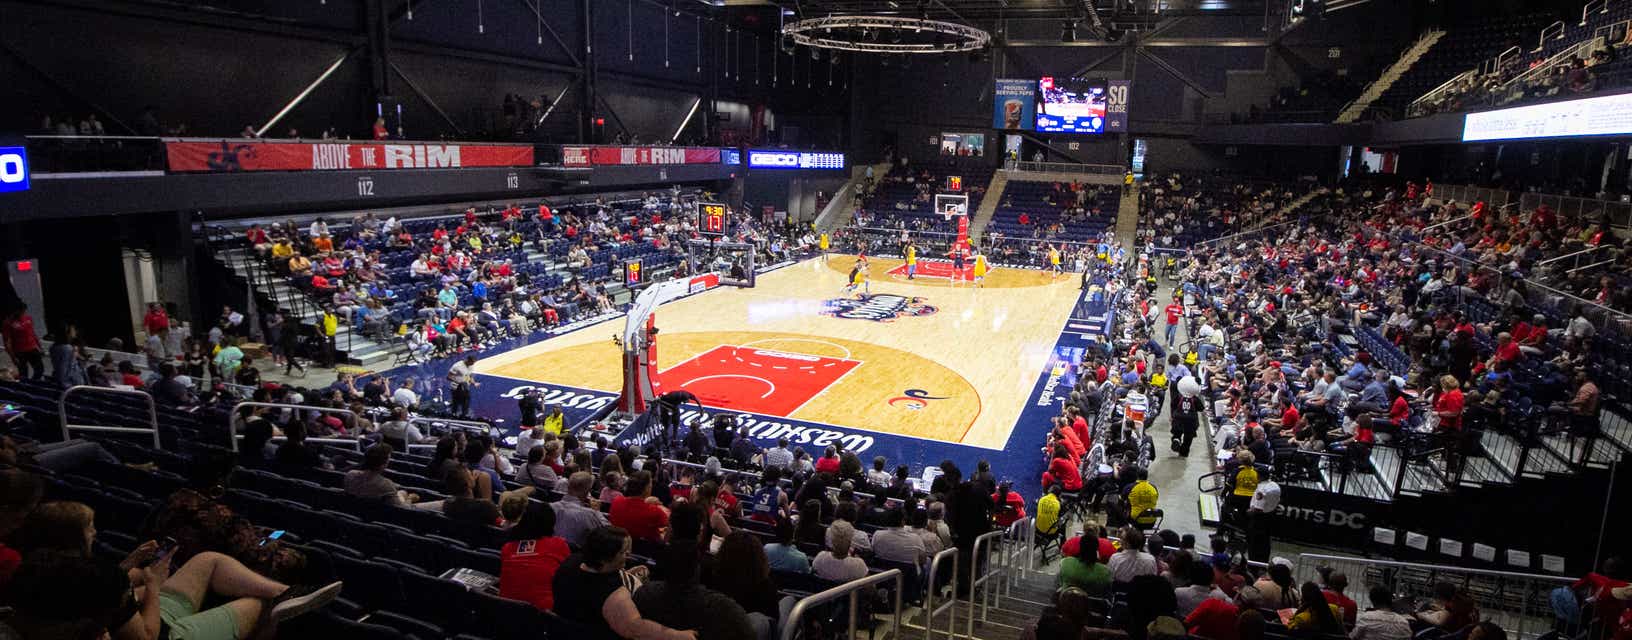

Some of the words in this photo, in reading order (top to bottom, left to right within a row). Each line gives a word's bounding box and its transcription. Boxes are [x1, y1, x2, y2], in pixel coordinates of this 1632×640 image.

[1109, 86, 1127, 105] SO
[1108, 105, 1127, 113] CLOSE
[312, 144, 352, 170] ABOVE
[361, 147, 377, 166] THE
[384, 144, 462, 169] RIM
[650, 148, 686, 165] RIM
[750, 153, 798, 166] GEICO
[358, 180, 375, 196] 112
[760, 493, 770, 505] 3
[1329, 509, 1366, 529] DC
